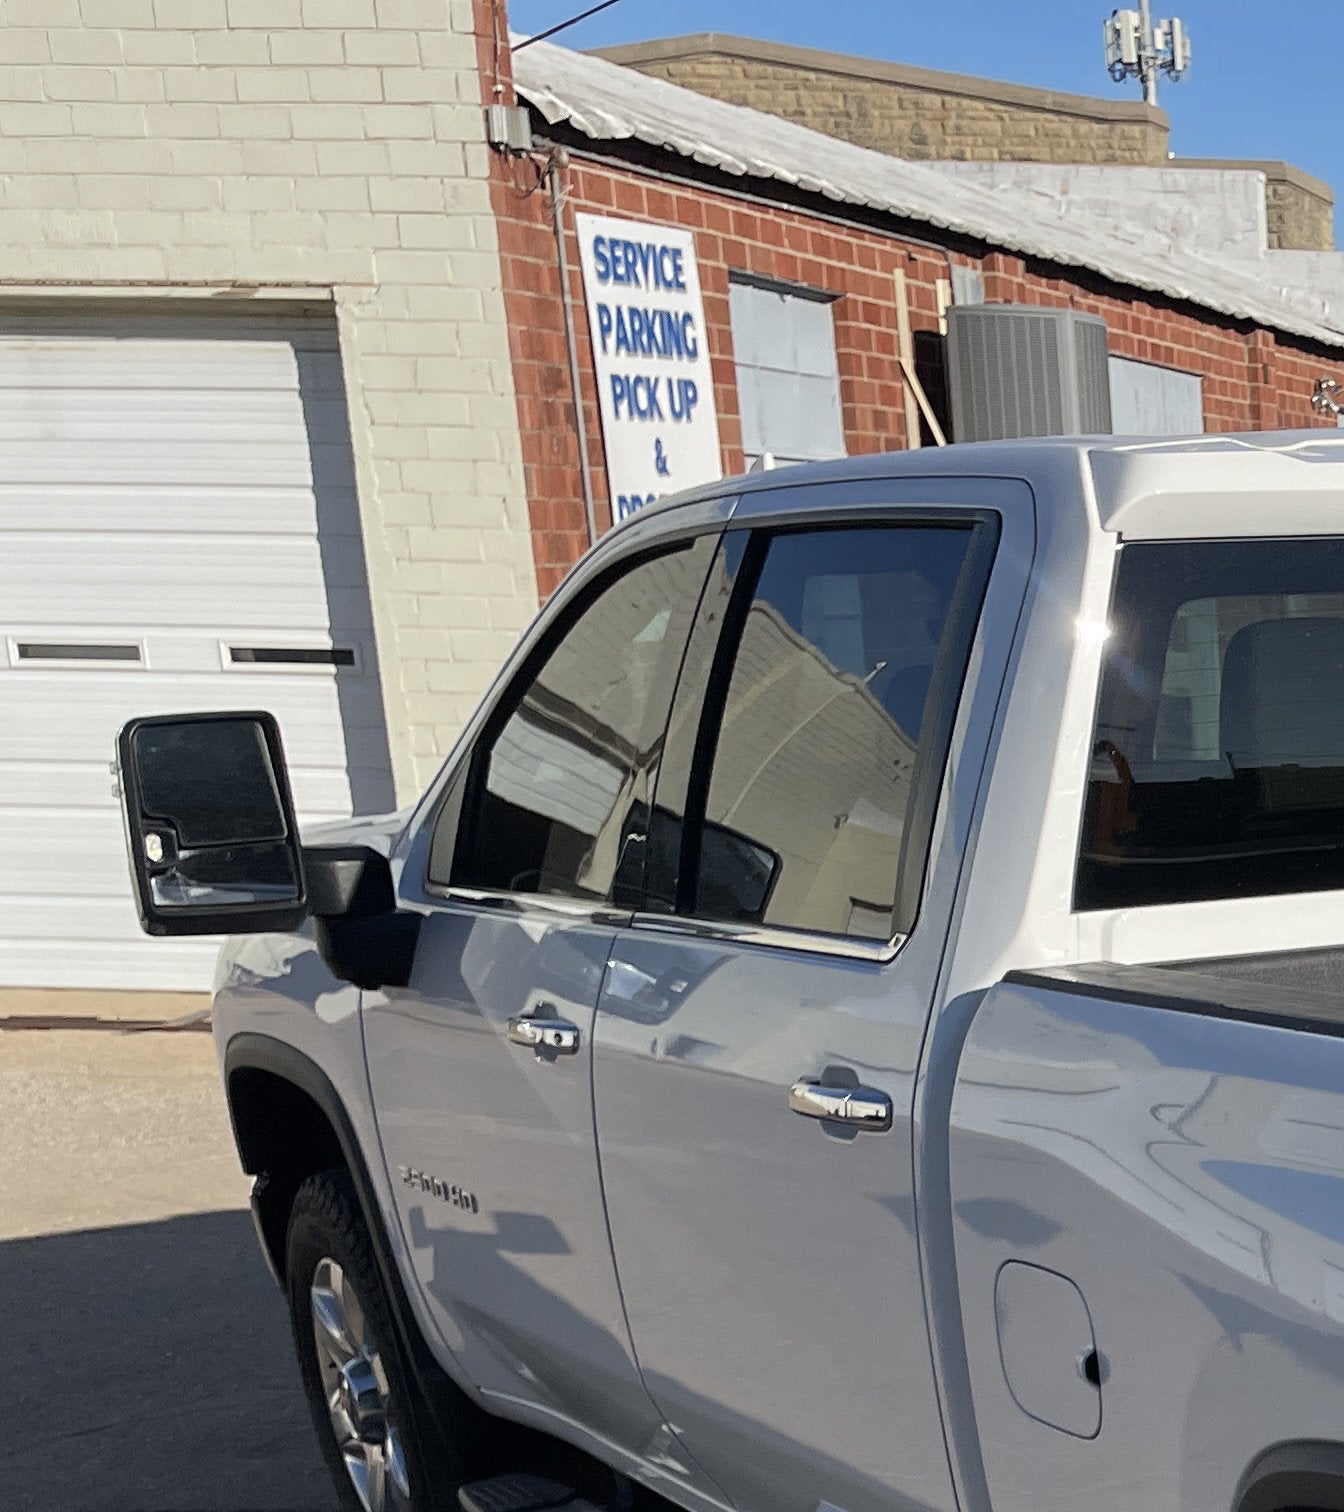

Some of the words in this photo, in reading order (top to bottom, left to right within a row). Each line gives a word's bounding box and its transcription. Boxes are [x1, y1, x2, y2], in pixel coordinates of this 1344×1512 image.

[593, 235, 685, 291] SERVICE
[597, 303, 698, 358] PARKING
[610, 374, 664, 421] PICK
[667, 377, 698, 422] UP
[655, 437, 671, 477] &
